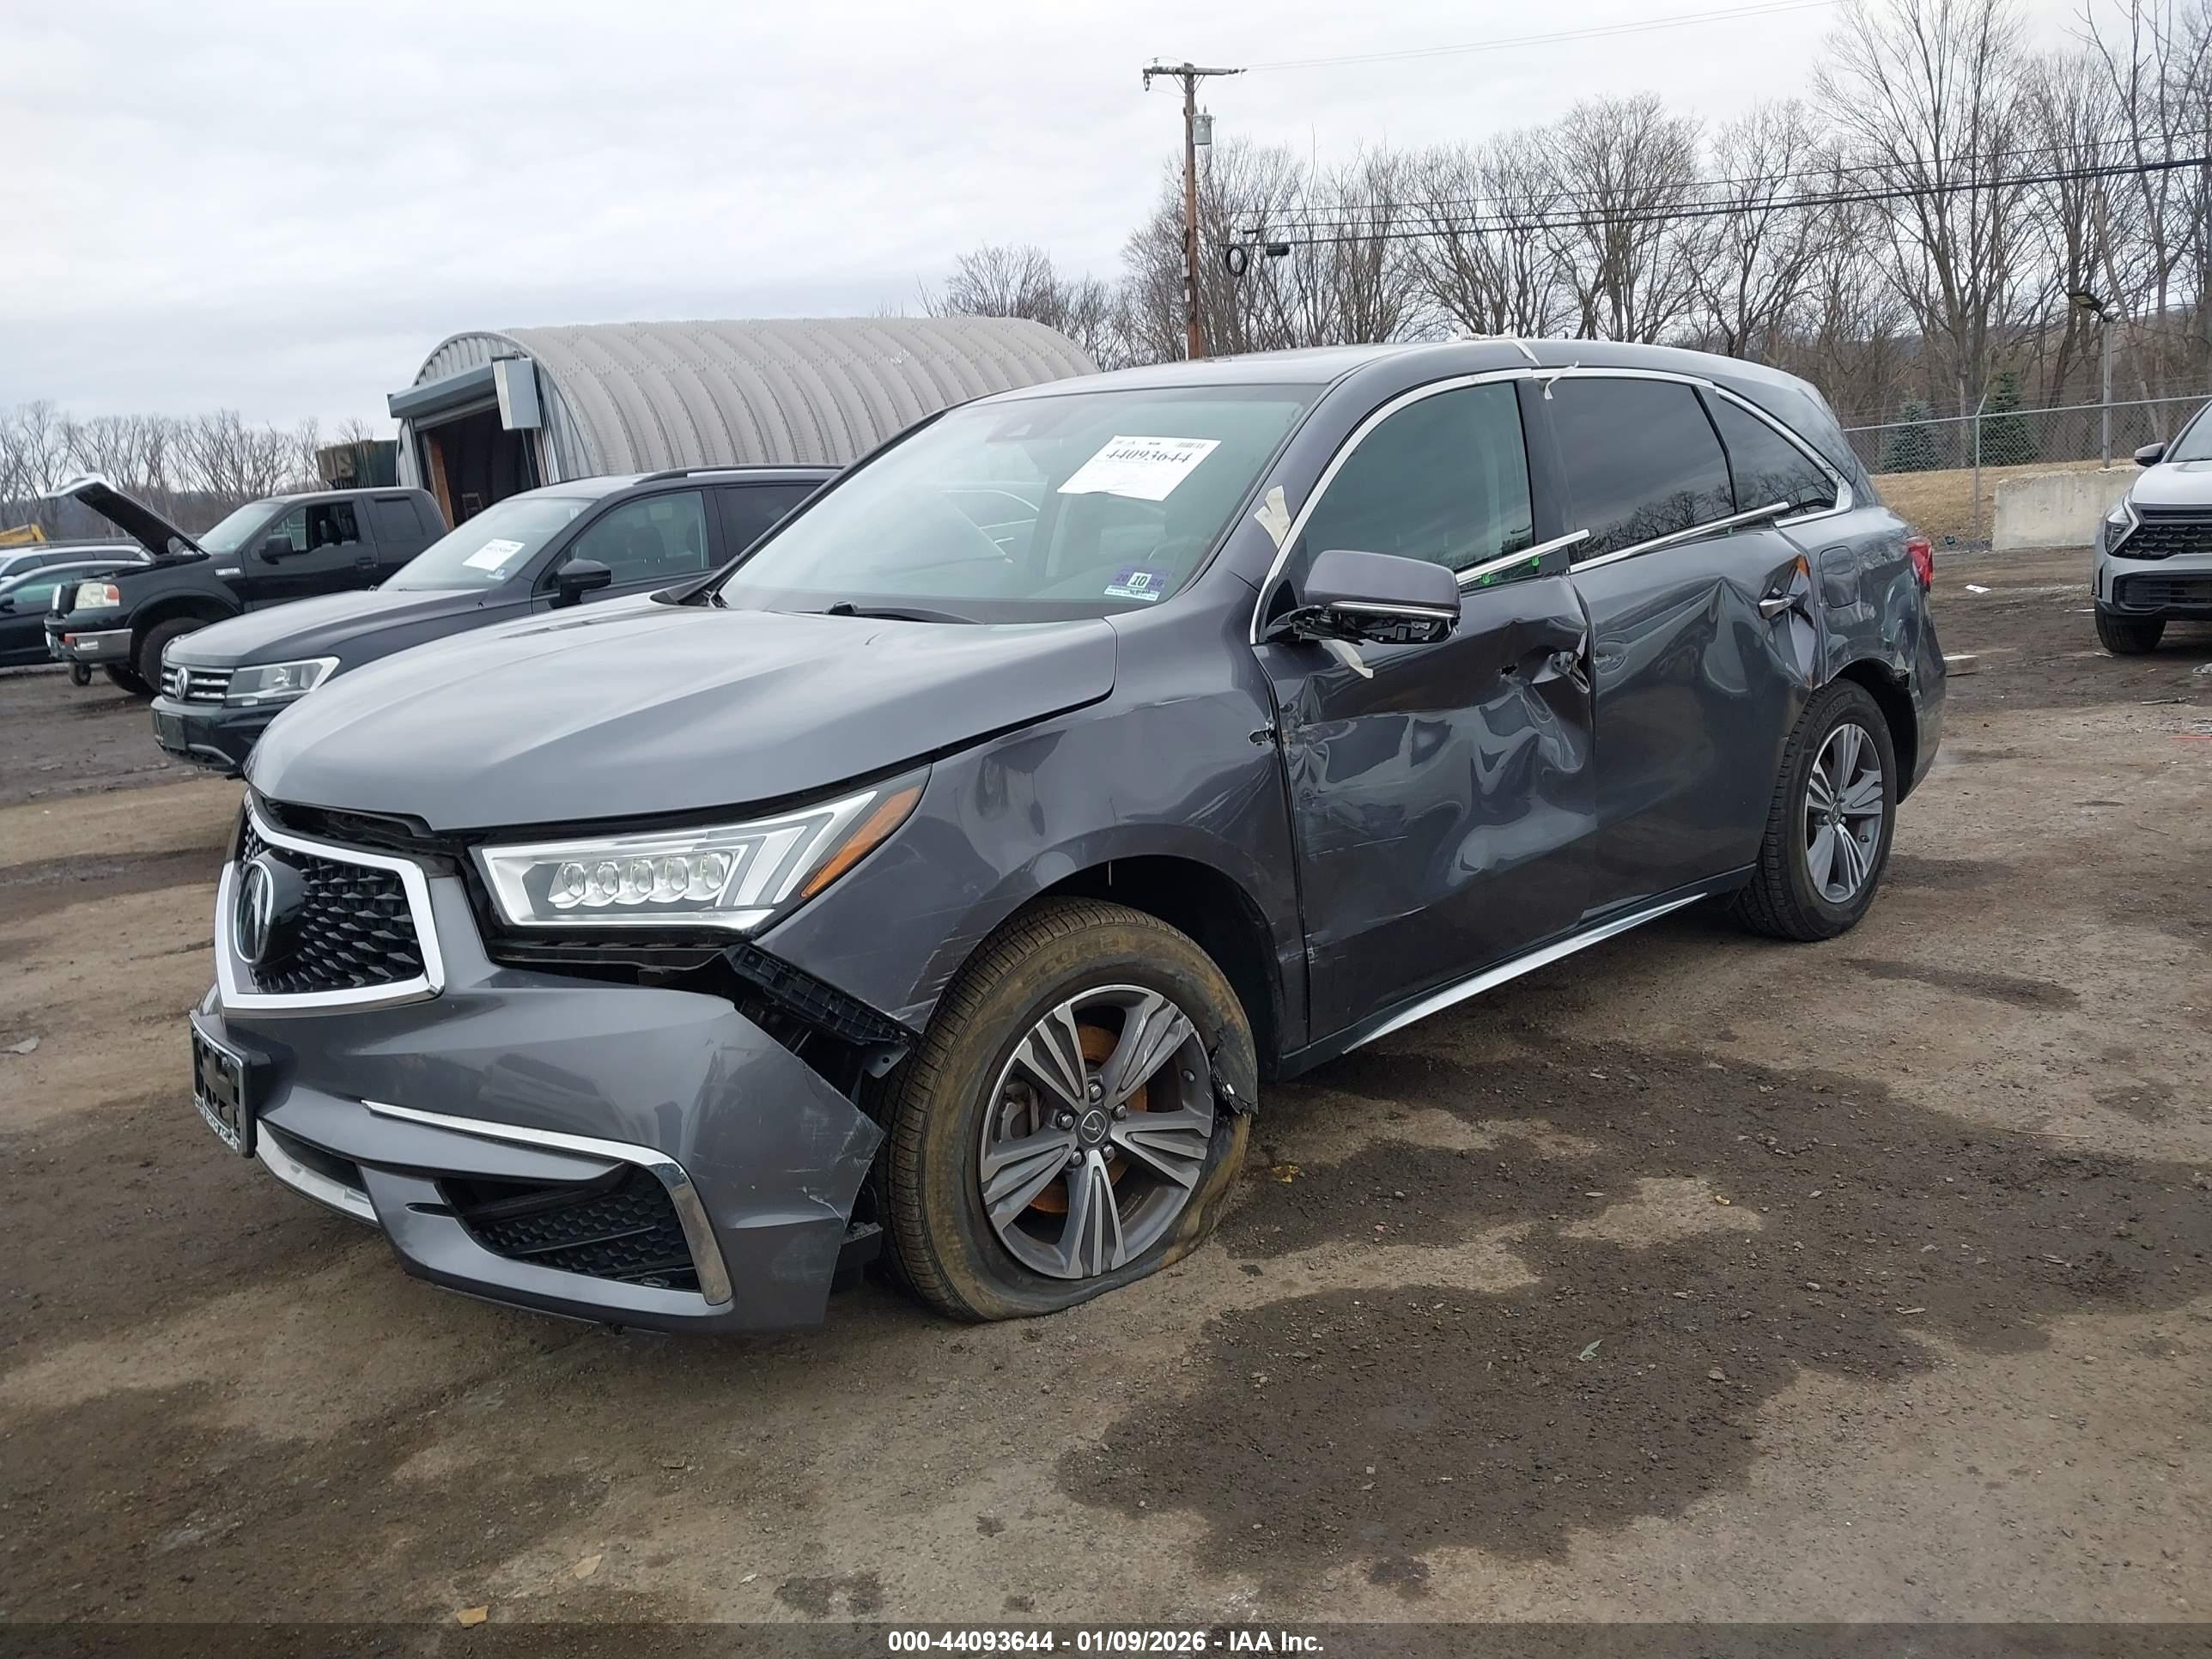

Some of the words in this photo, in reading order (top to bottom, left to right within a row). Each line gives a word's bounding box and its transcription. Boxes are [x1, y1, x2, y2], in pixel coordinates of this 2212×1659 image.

[1105, 448, 1194, 463] 44093644
[1130, 575, 1148, 586] 10
[219, 1127, 239, 1153] ACURA
